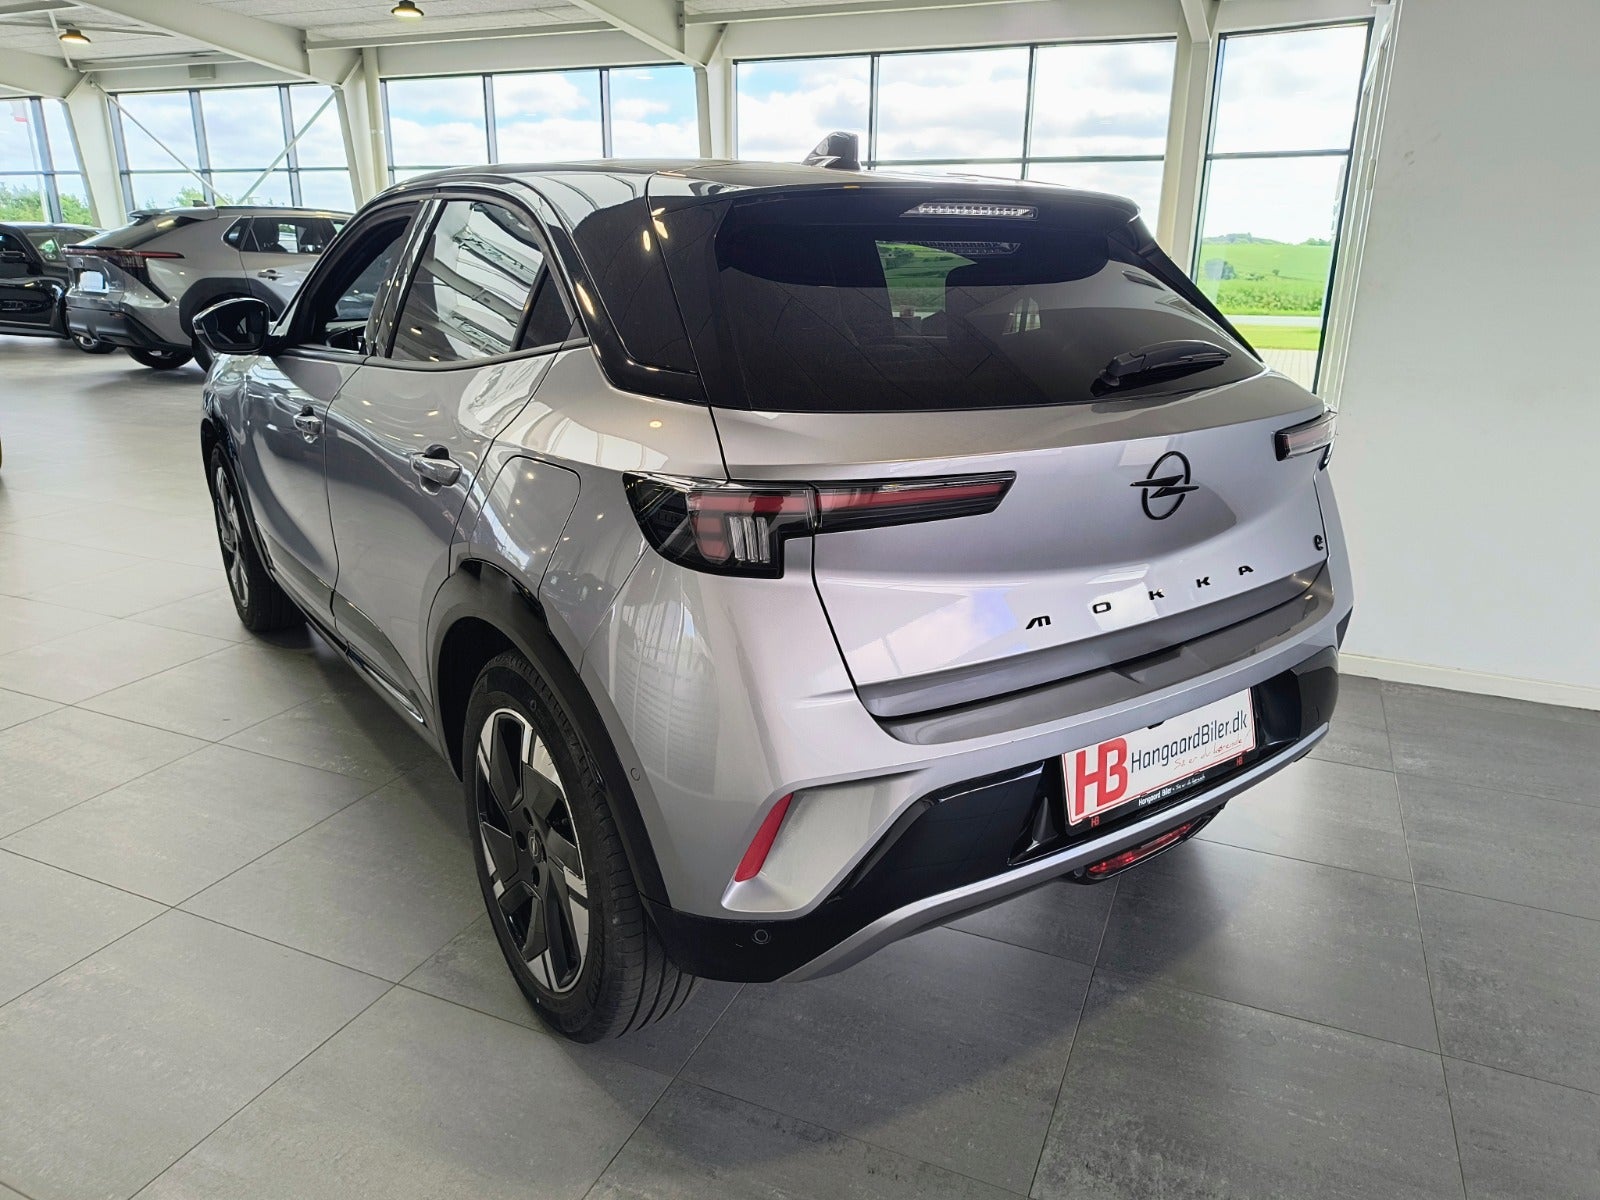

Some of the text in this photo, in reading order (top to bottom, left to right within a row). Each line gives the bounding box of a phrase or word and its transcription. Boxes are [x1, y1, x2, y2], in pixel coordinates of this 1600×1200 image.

[1025, 565, 1254, 630] MOKKA
[1131, 710, 1248, 773] HangaardBiler.dk
[1075, 737, 1128, 816] HB
[1091, 816, 1100, 828] HB
